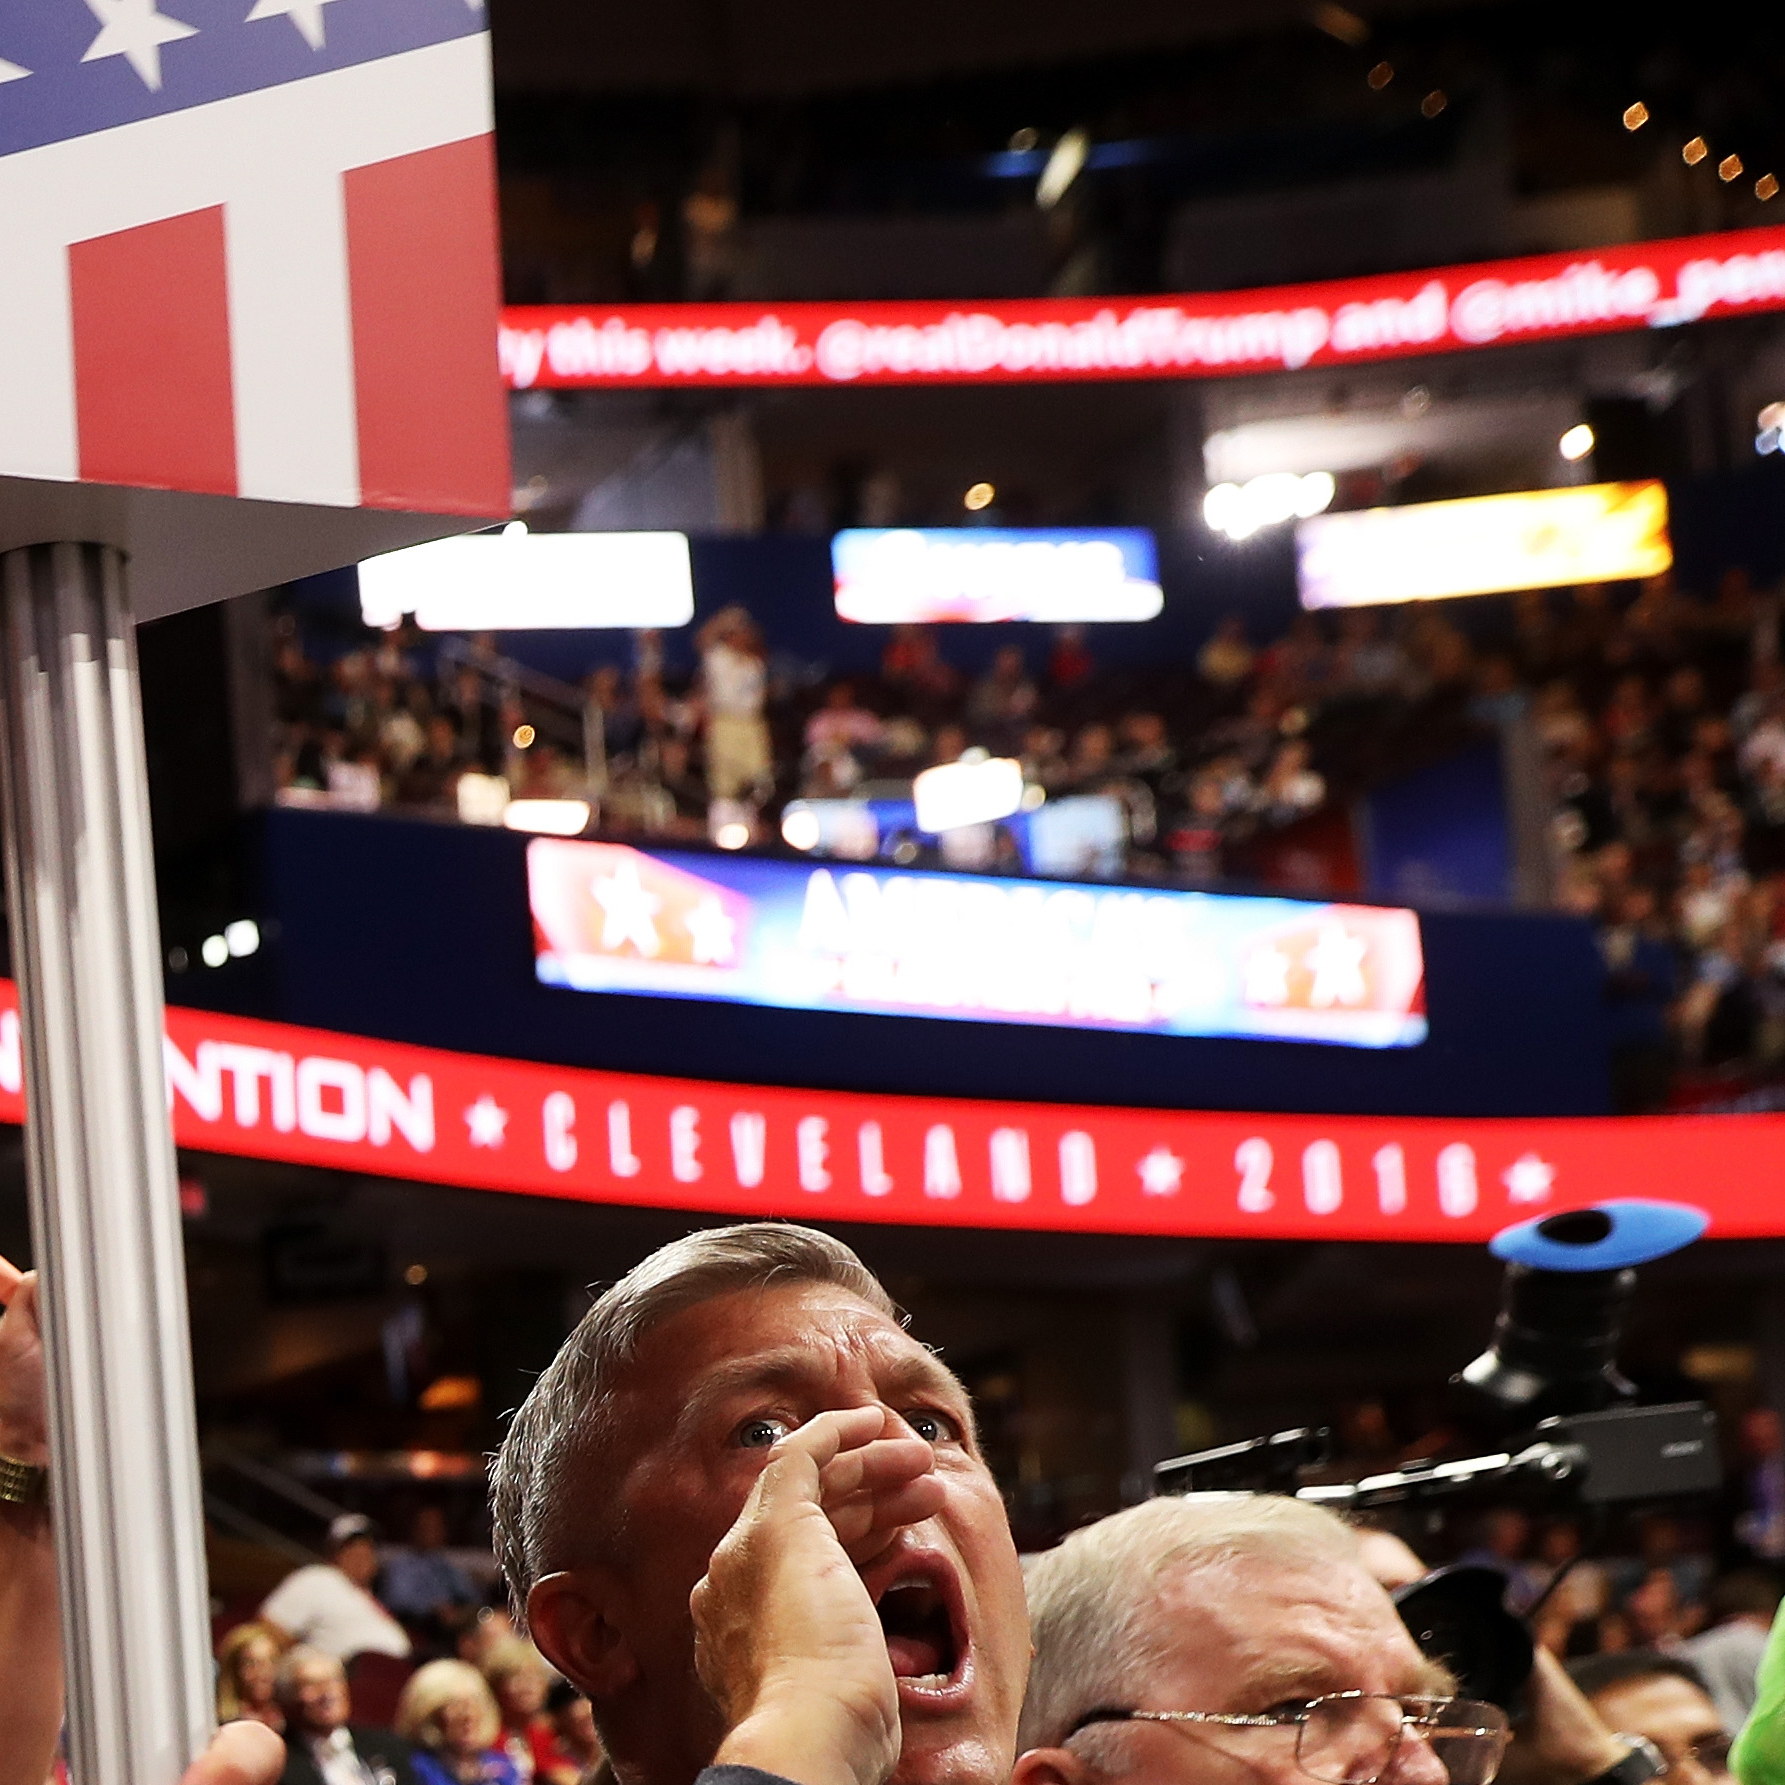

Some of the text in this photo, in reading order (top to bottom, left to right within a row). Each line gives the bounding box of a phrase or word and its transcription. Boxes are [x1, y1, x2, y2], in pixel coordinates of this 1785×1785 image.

[547, 316, 652, 374] this
[655, 315, 813, 374] week.
[816, 307, 1328, 380] @realDonaldTrump
[1331, 281, 1449, 352] and
[542, 1090, 1098, 1206] CLEVELAND
[1234, 1137, 1479, 1217] 2016
